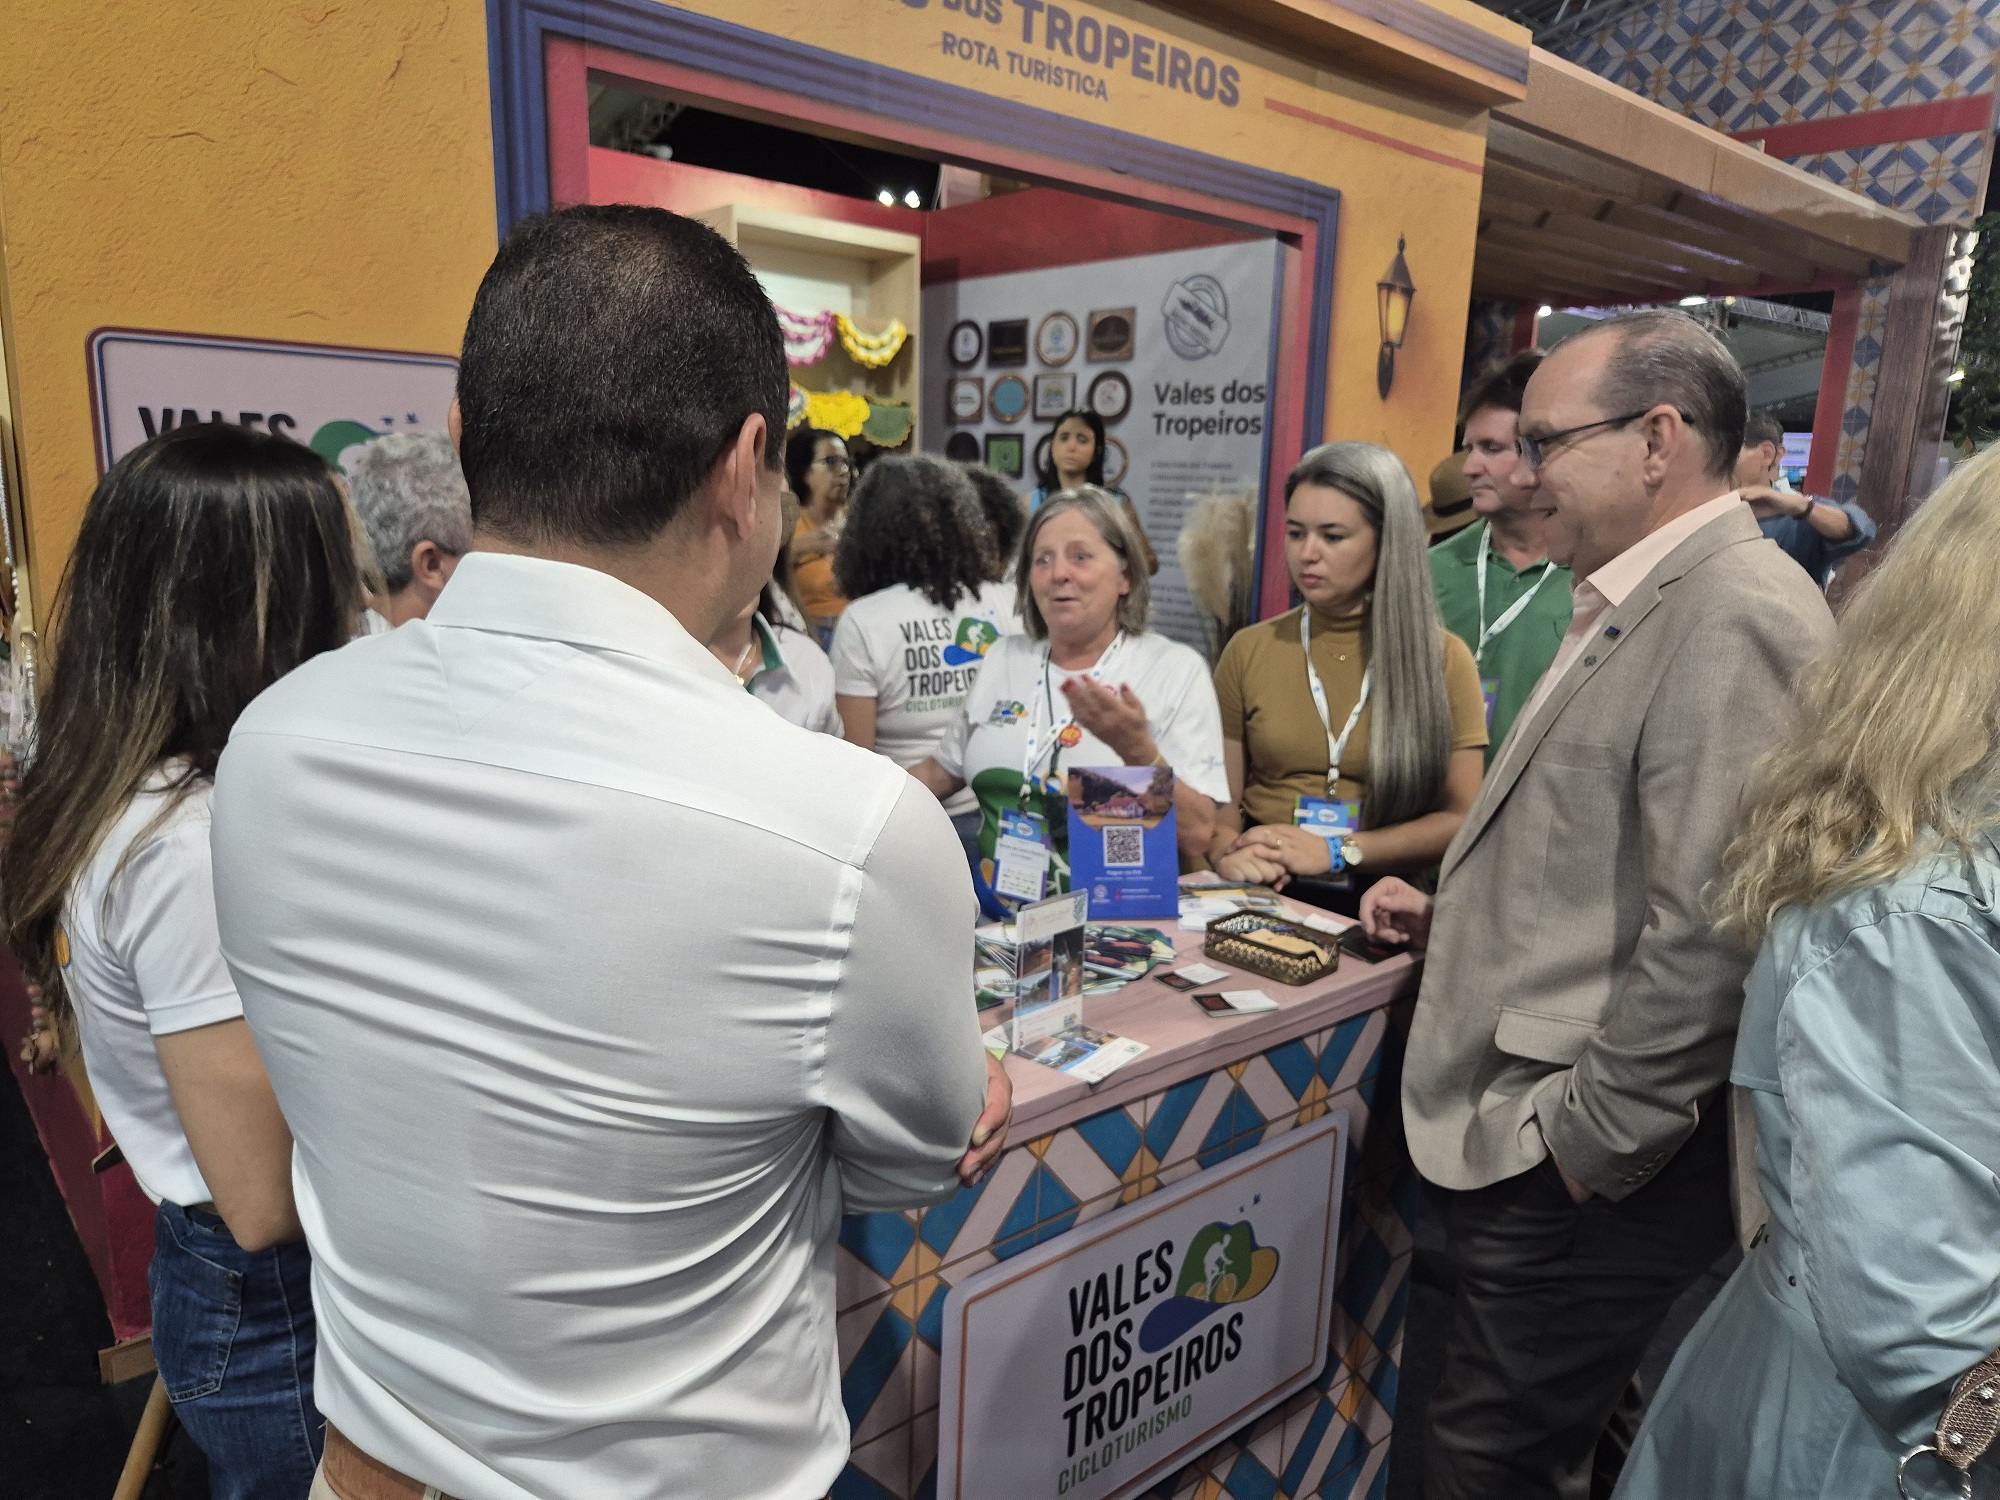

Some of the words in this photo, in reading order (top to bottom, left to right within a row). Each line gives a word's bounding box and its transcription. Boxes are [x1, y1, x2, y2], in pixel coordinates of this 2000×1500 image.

[941, 31, 999, 71] ROTA
[1006, 50, 1108, 101] TURÍSTICA
[1013, 0, 1240, 108] TROPEIROS
[1153, 409, 1262, 440] Tropeiros
[1154, 381, 1214, 405] Vales
[1222, 379, 1265, 404] dos
[900, 618, 953, 643] VALES
[905, 645, 941, 671] DOS
[908, 667, 978, 697] TROPEIR
[1068, 1239, 1174, 1338] VALES
[1062, 1311, 1244, 1458] TROPEIROS
[1063, 1317, 1133, 1402] DOS
[1057, 1393, 1193, 1496] CICLOTURISMO
